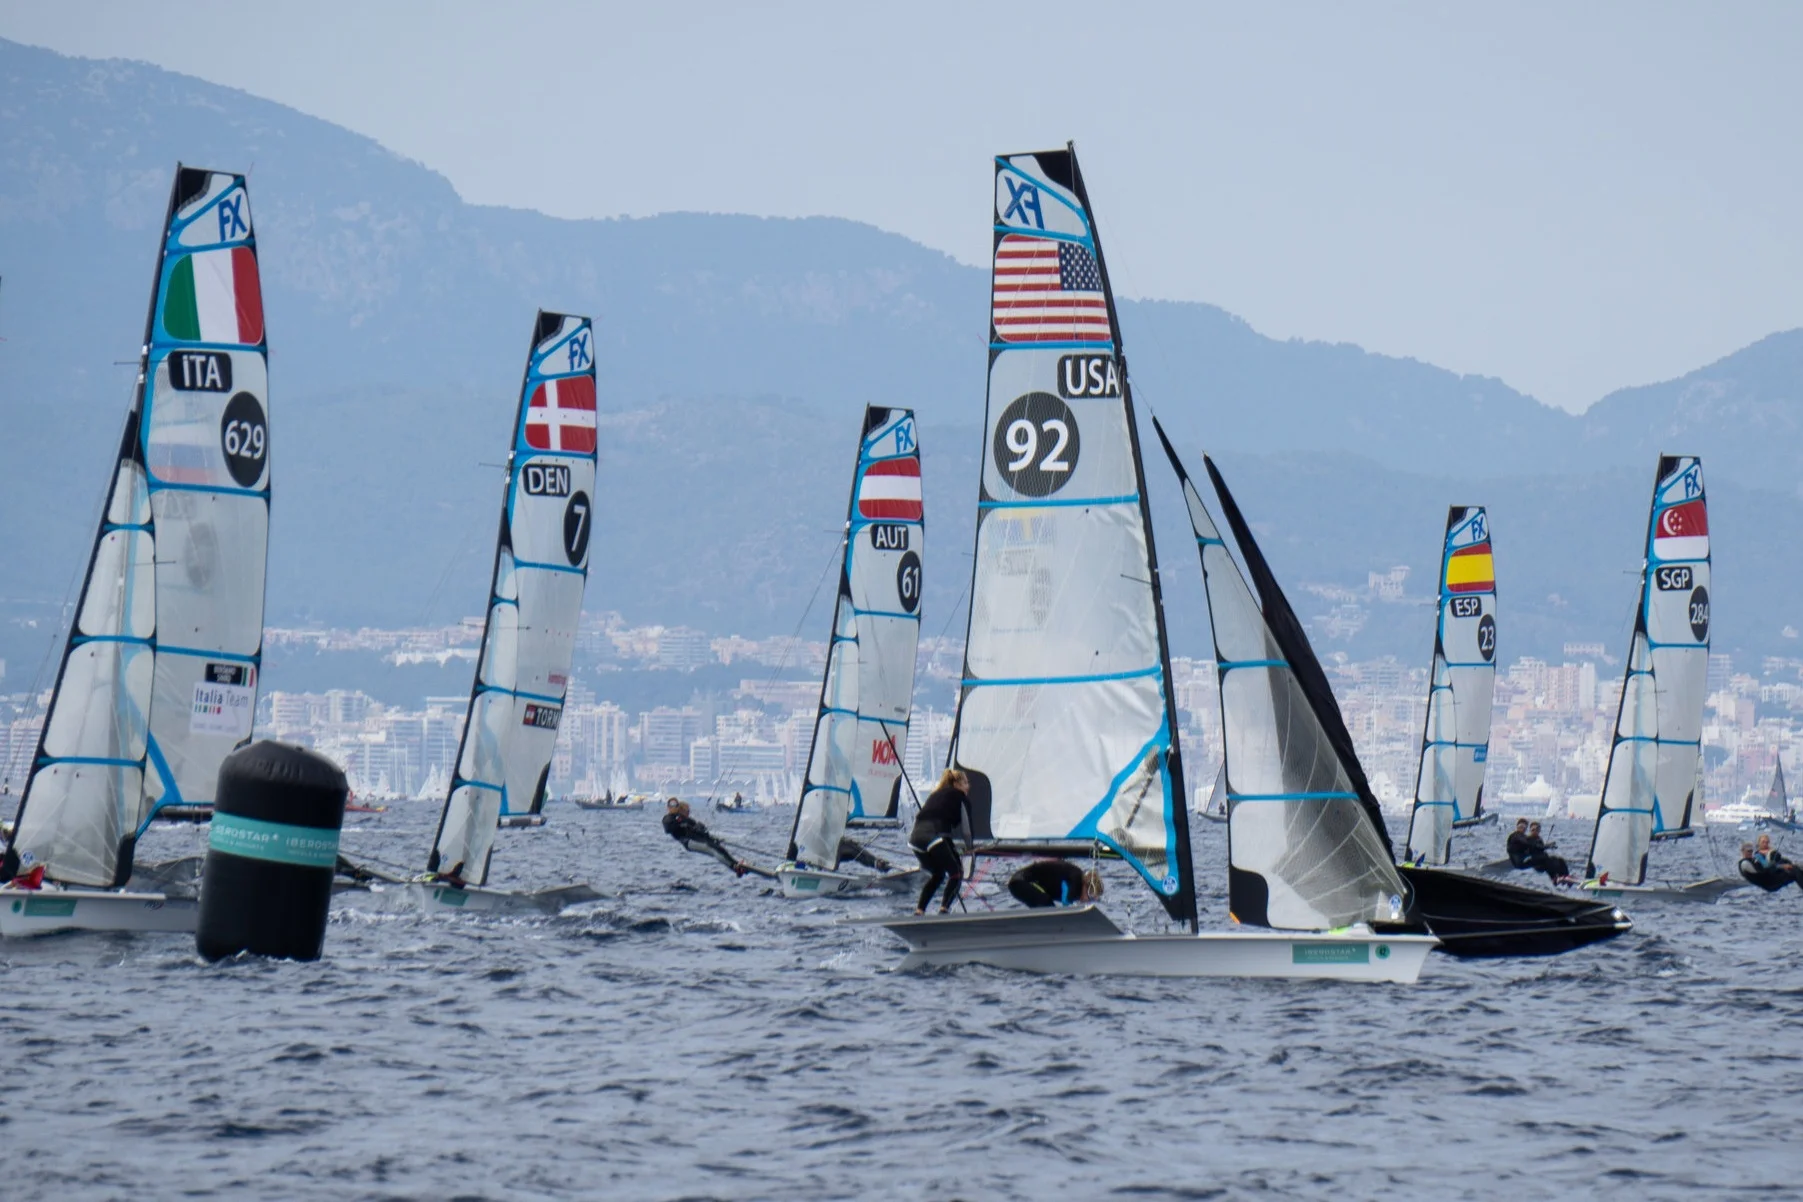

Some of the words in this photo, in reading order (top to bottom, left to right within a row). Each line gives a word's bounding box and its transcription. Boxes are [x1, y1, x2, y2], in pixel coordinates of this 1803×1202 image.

[218, 194, 248, 242] FX
[568, 333, 591, 371] FX
[182, 354, 222, 388] ITA
[1064, 358, 1120, 396] USA
[224, 420, 265, 459] 629
[894, 422, 915, 454] FX
[1005, 418, 1069, 472] 92
[527, 467, 569, 494] DEN
[1684, 469, 1701, 499] FX
[570, 504, 586, 552] 7
[875, 526, 907, 548] AUT
[1470, 515, 1487, 541] FX
[902, 566, 919, 598] 61
[1660, 568, 1691, 589] SGP
[1455, 598, 1479, 617] ESP
[1690, 603, 1709, 626] 284
[1480, 625, 1494, 651] 23
[195, 687, 223, 704] Italia
